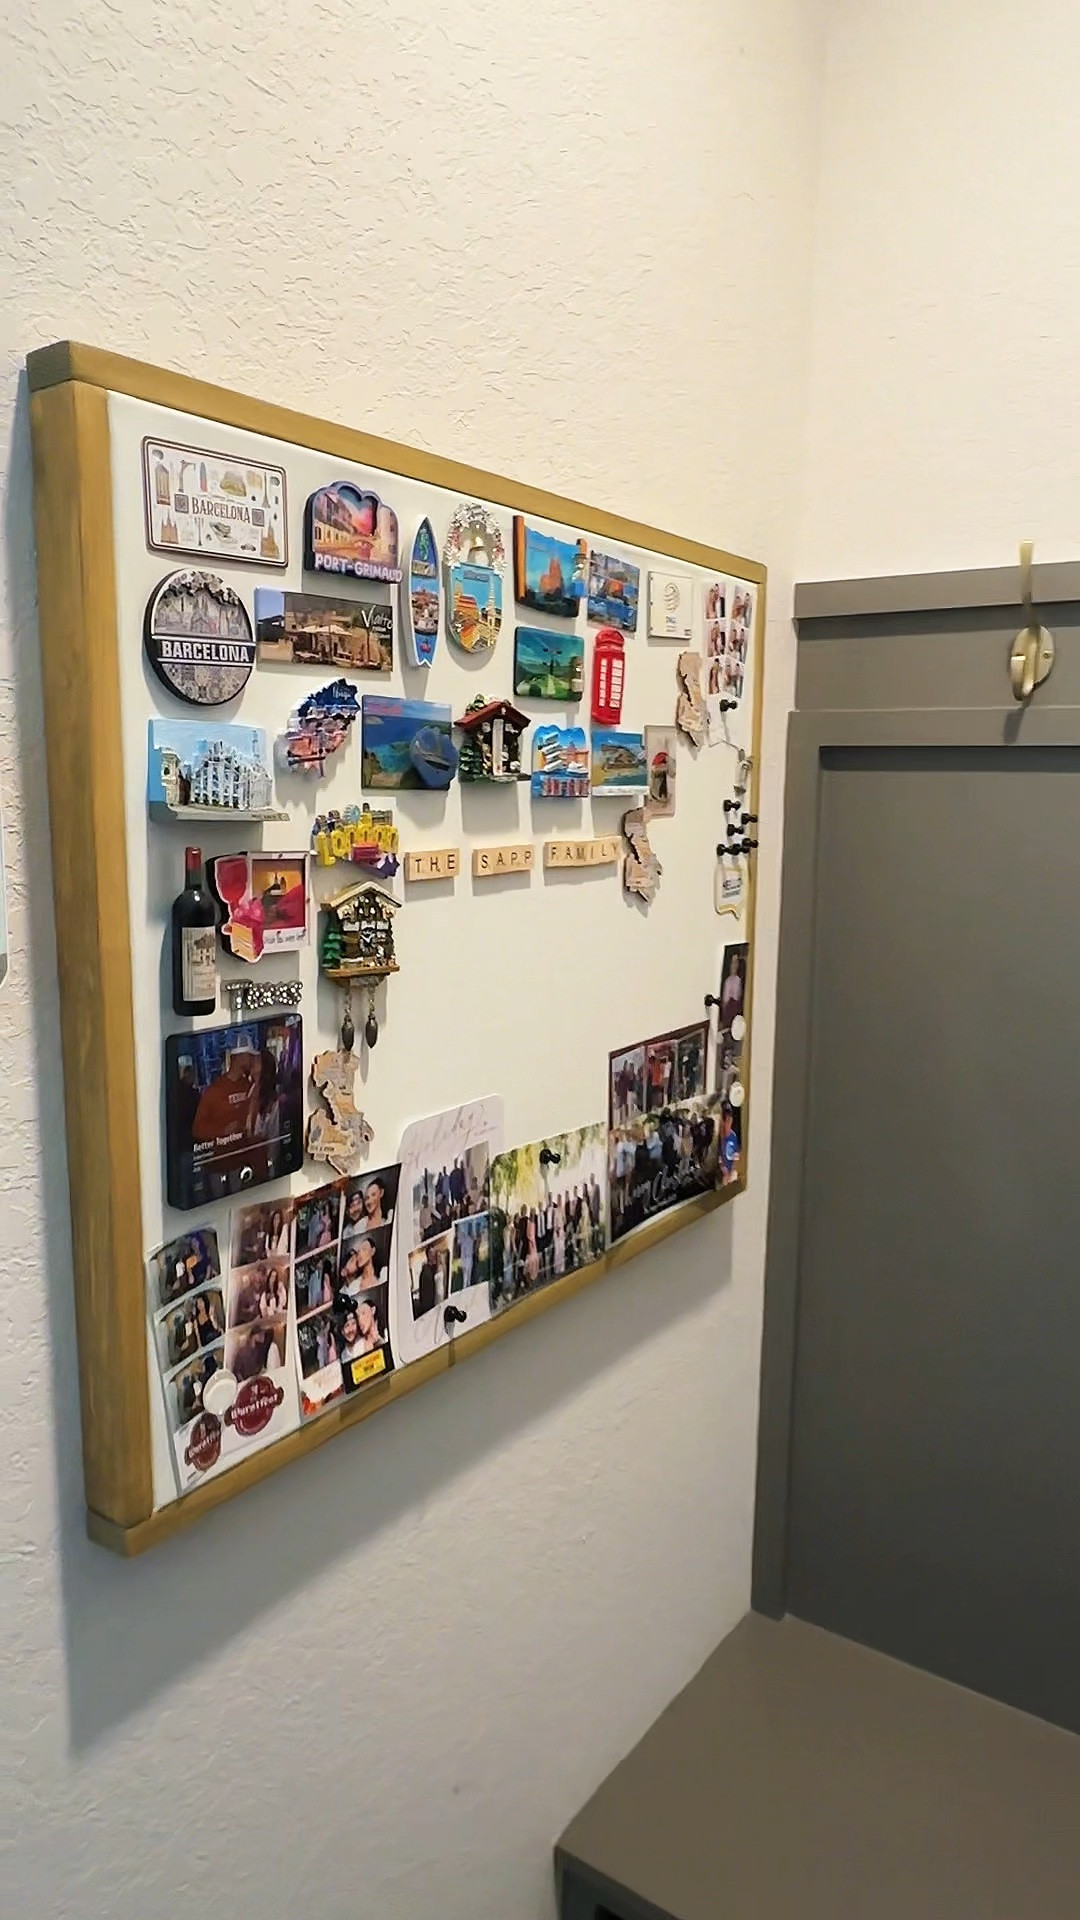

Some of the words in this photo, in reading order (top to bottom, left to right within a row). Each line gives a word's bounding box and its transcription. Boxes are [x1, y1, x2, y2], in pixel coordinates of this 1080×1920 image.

[192, 497, 250, 523] BARCELONA
[314, 552, 403, 582] PORT-GRIMAUD
[161, 640, 250, 662] BARCELONA
[415, 854, 456, 873] THE
[480, 851, 532, 869] SAPP
[551, 844, 619, 861] FAMILY
